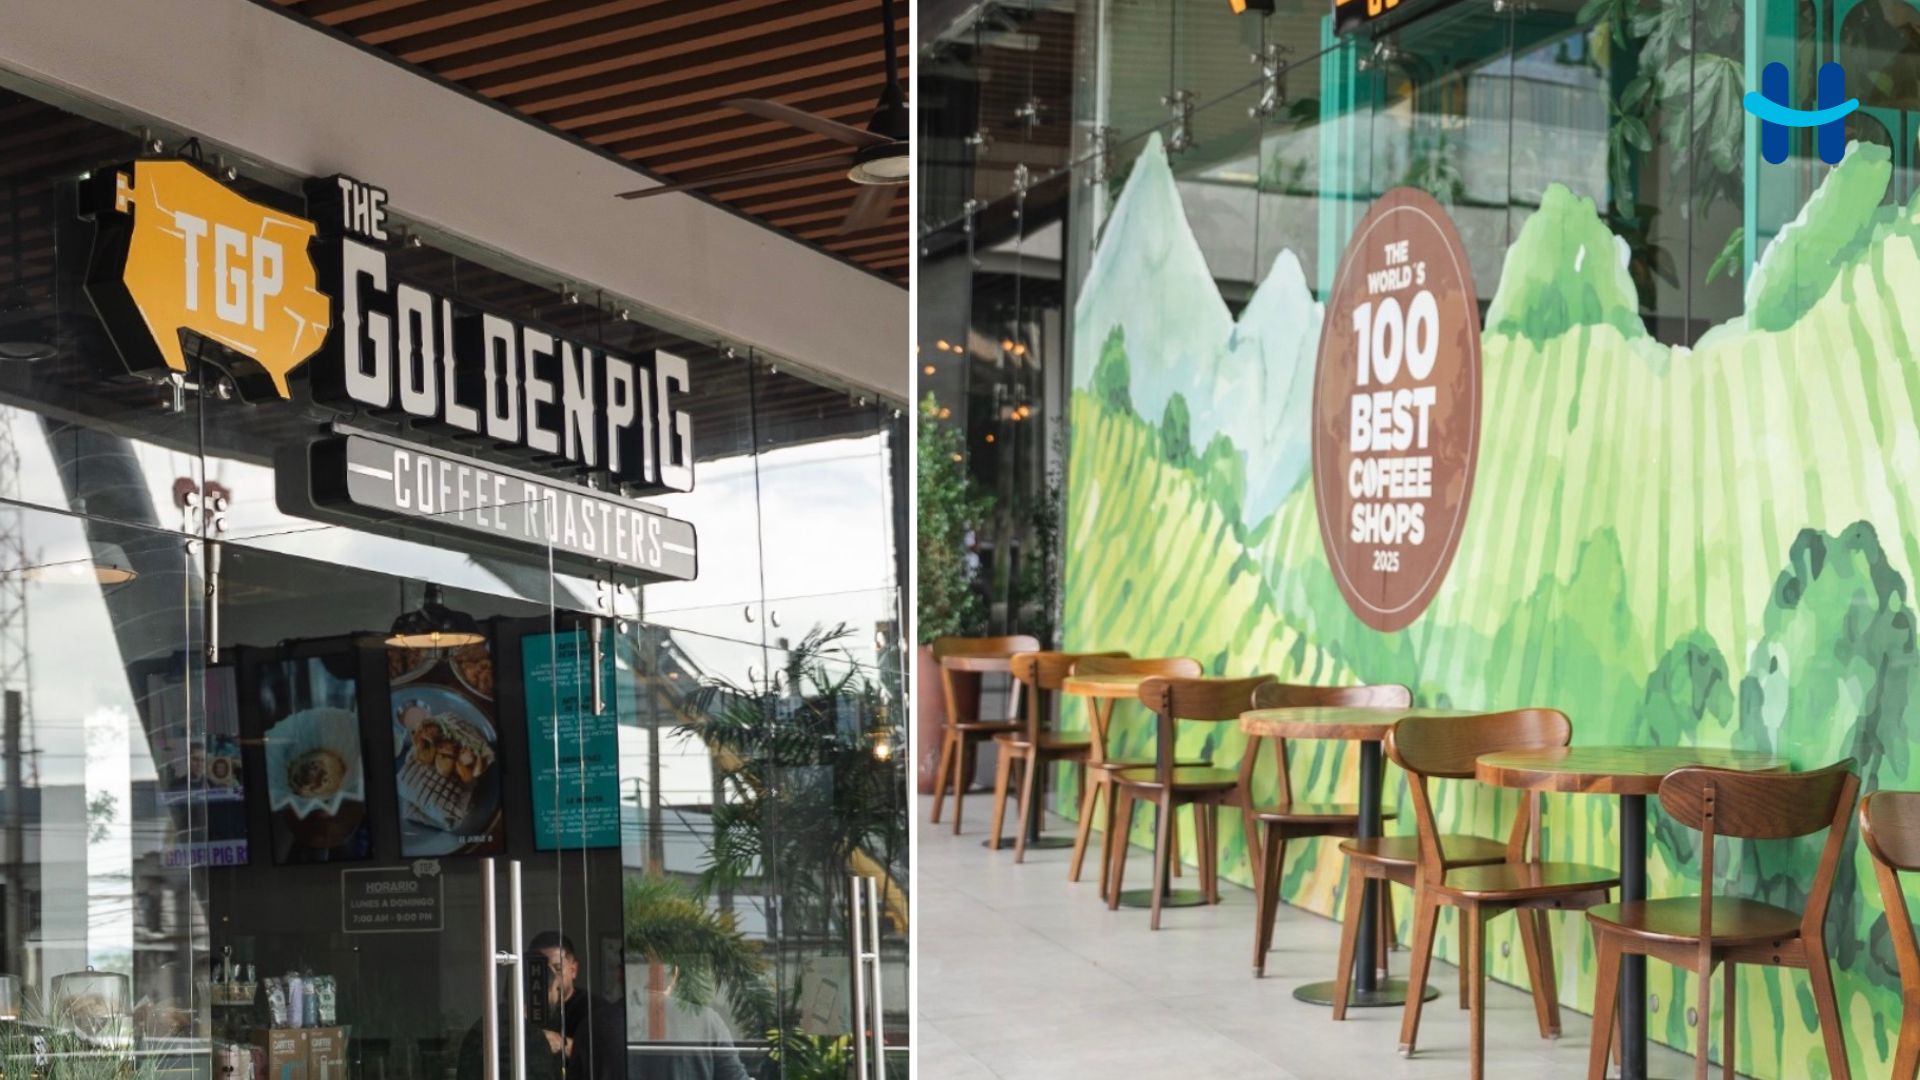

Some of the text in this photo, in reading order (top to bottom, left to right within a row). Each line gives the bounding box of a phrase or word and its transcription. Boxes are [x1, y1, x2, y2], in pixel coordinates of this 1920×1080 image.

[338, 177, 388, 241] THE
[174, 212, 284, 331] TGP
[1384, 240, 1409, 266] THE
[342, 240, 598, 467] GOLDEN
[1352, 290, 1440, 386] 100
[1349, 386, 1437, 453] BEST
[393, 449, 663, 569] COFFEE ROASTERS
[1350, 502, 1426, 546] SHOPS
[1372, 550, 1400, 572] 2025
[213, 846, 234, 864] PIG
[351, 899, 380, 909] LUNES
[390, 897, 435, 908] DOMINGO
[366, 881, 417, 893] HORARIO
[374, 914, 389, 922] AM
[418, 912, 432, 921] PM
[531, 964, 542, 1020] HALE
